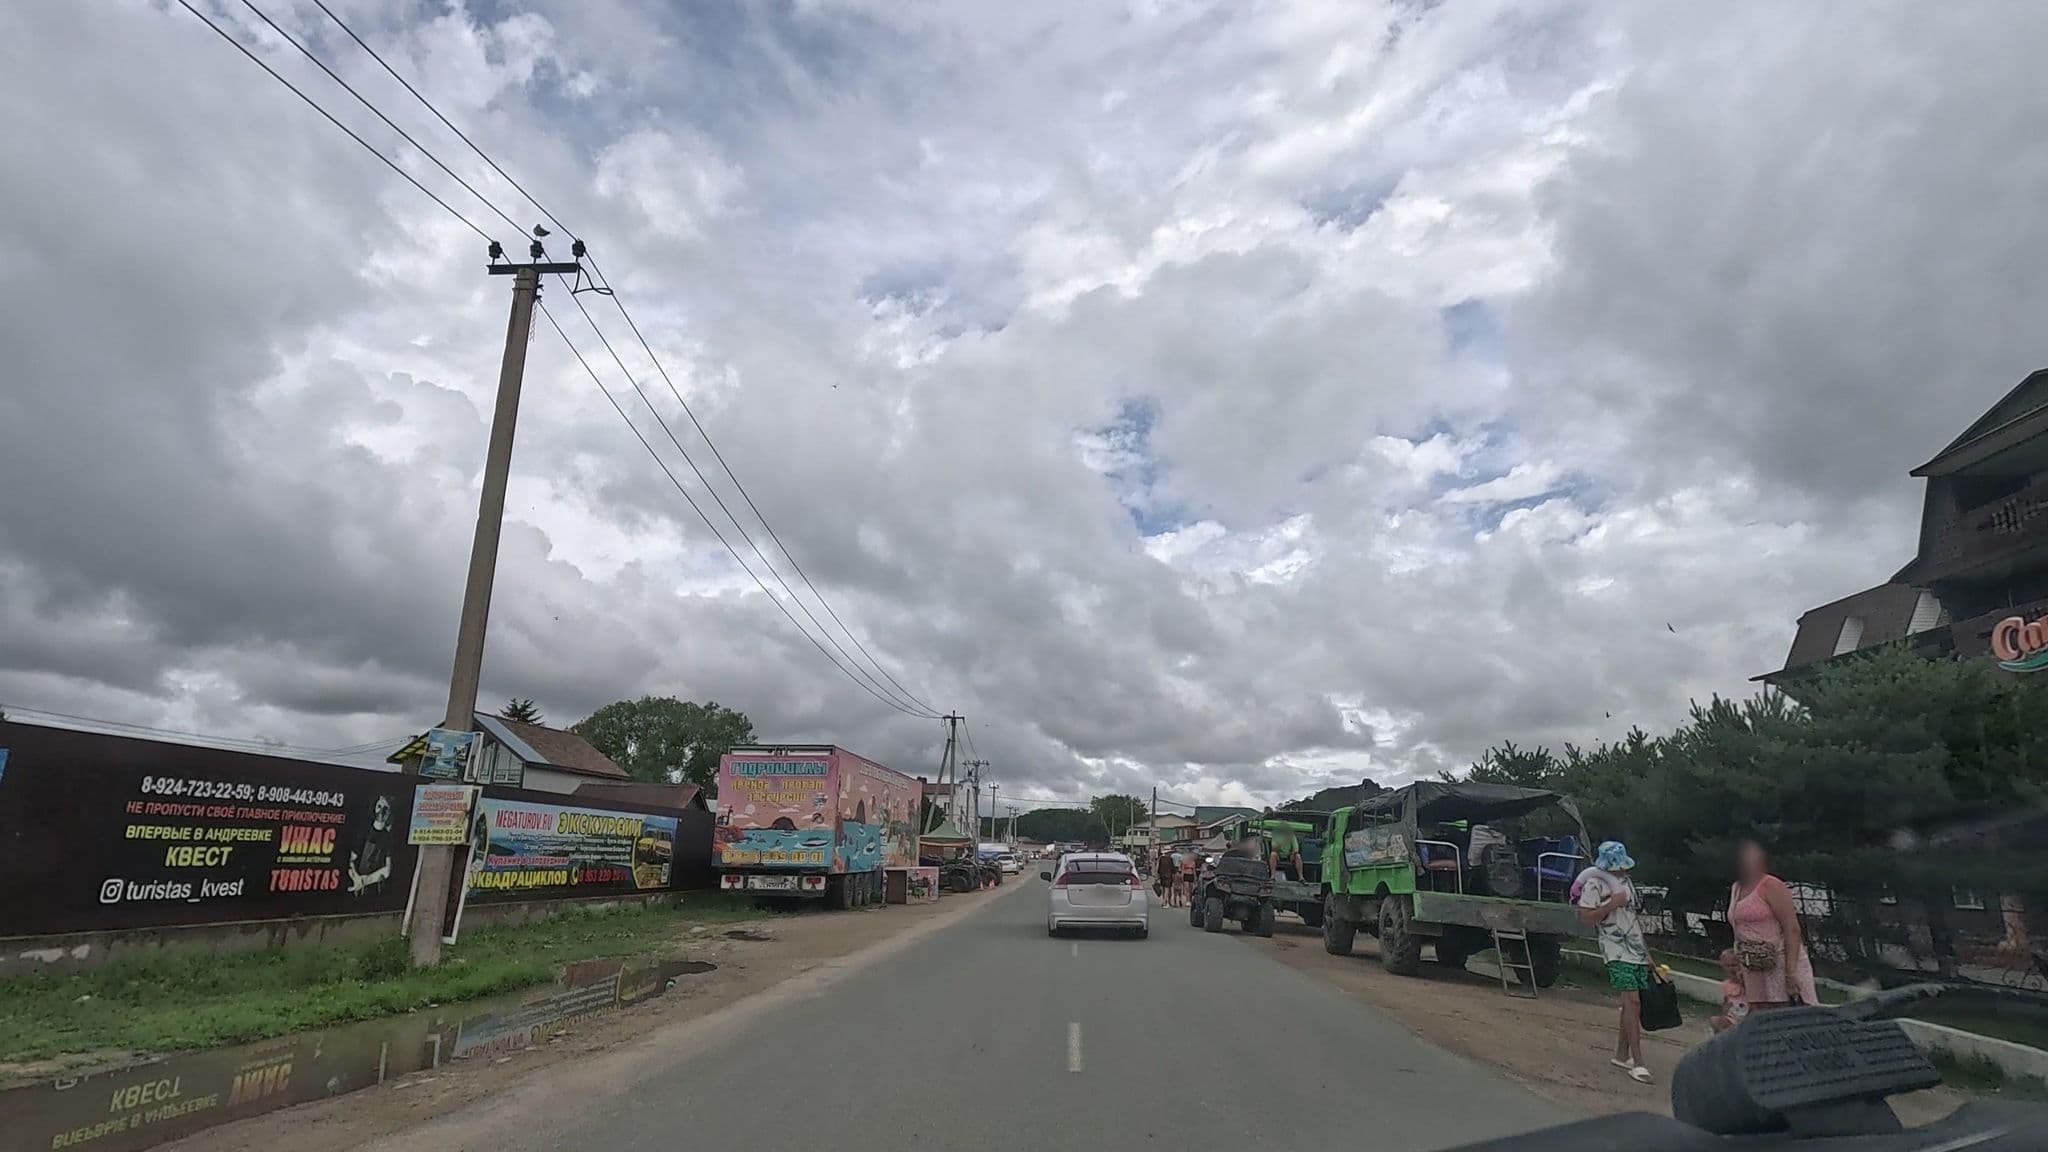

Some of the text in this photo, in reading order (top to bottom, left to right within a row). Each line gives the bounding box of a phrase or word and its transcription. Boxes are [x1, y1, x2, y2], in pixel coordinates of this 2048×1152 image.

[141, 775, 344, 807] 8-924-723-22-59; 8-908-443-90-43
[126, 801, 144, 814] НЕ
[145, 802, 205, 816] ПРОПУСТИ
[236, 807, 281, 820] ГЛАВНОЕ
[125, 825, 273, 843] ВПЕРВЫЕ В АНДРЕЕВКЕ
[557, 811, 643, 837] ЭКСКУРСИИ
[279, 825, 336, 854] УЖАС
[165, 846, 233, 867] КВЕСТ
[126, 878, 244, 902] turistas_kvest
[270, 868, 340, 891] TURISTAS
[477, 870, 568, 889] КВАДРАЦИКЛОВ
